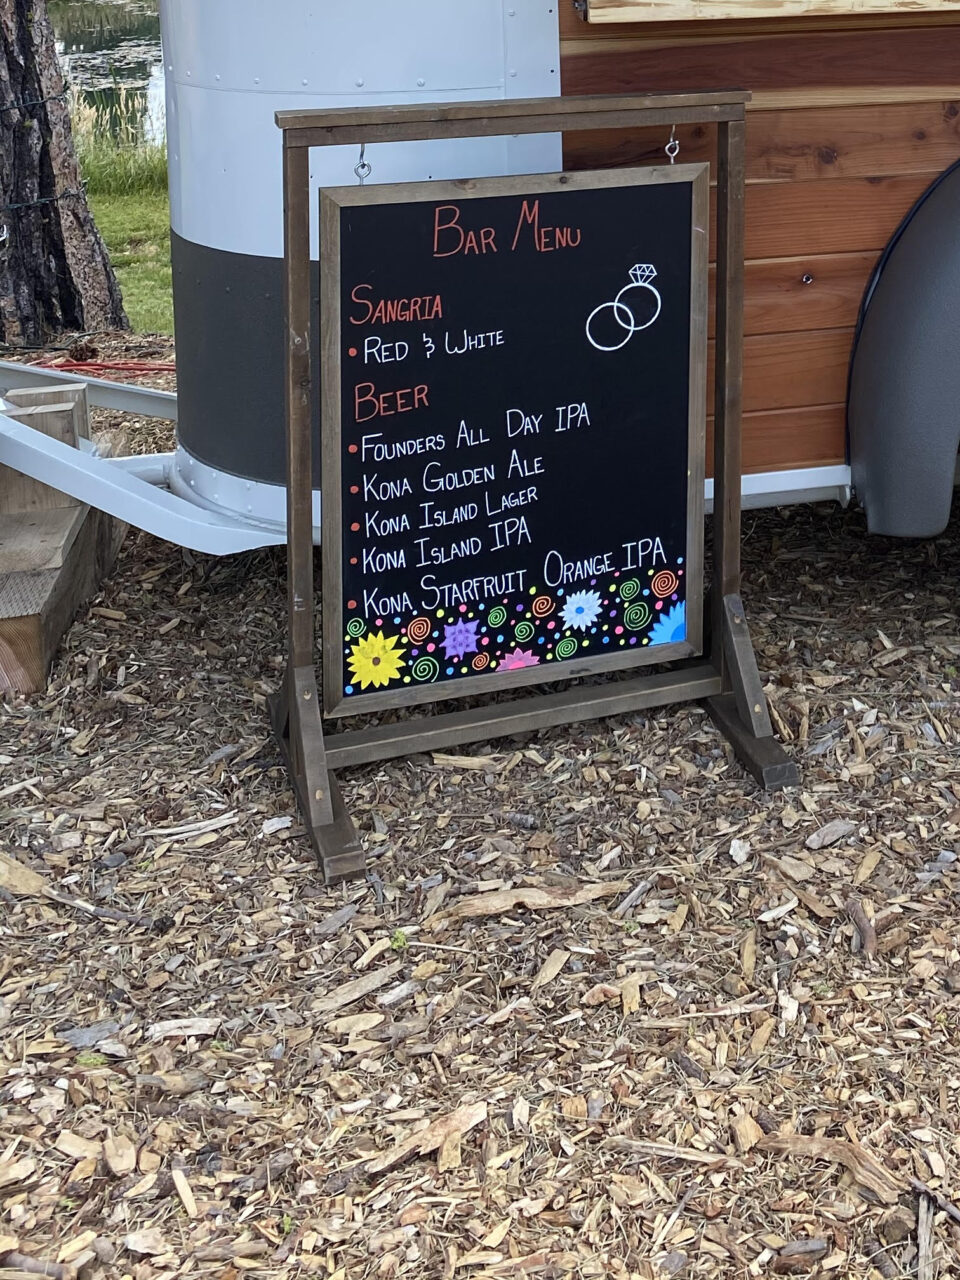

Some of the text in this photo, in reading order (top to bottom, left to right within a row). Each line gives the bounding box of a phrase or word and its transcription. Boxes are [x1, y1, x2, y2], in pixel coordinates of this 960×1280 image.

[432, 199, 581, 258] BAR MENU
[349, 284, 443, 326] SANGRIA
[364, 335, 409, 365] RED
[444, 328, 505, 356] WHITE
[354, 382, 430, 423] BEER
[361, 401, 591, 463] FOUNDERS ALL DAY IPA
[363, 448, 546, 502] KONA GOLDEN ALE
[364, 485, 539, 538] KONA ISLAND LAGER
[362, 515, 532, 574] KONA ISLAND IPA
[362, 536, 667, 618] KONA STARFRUIT ORANGE IPA
